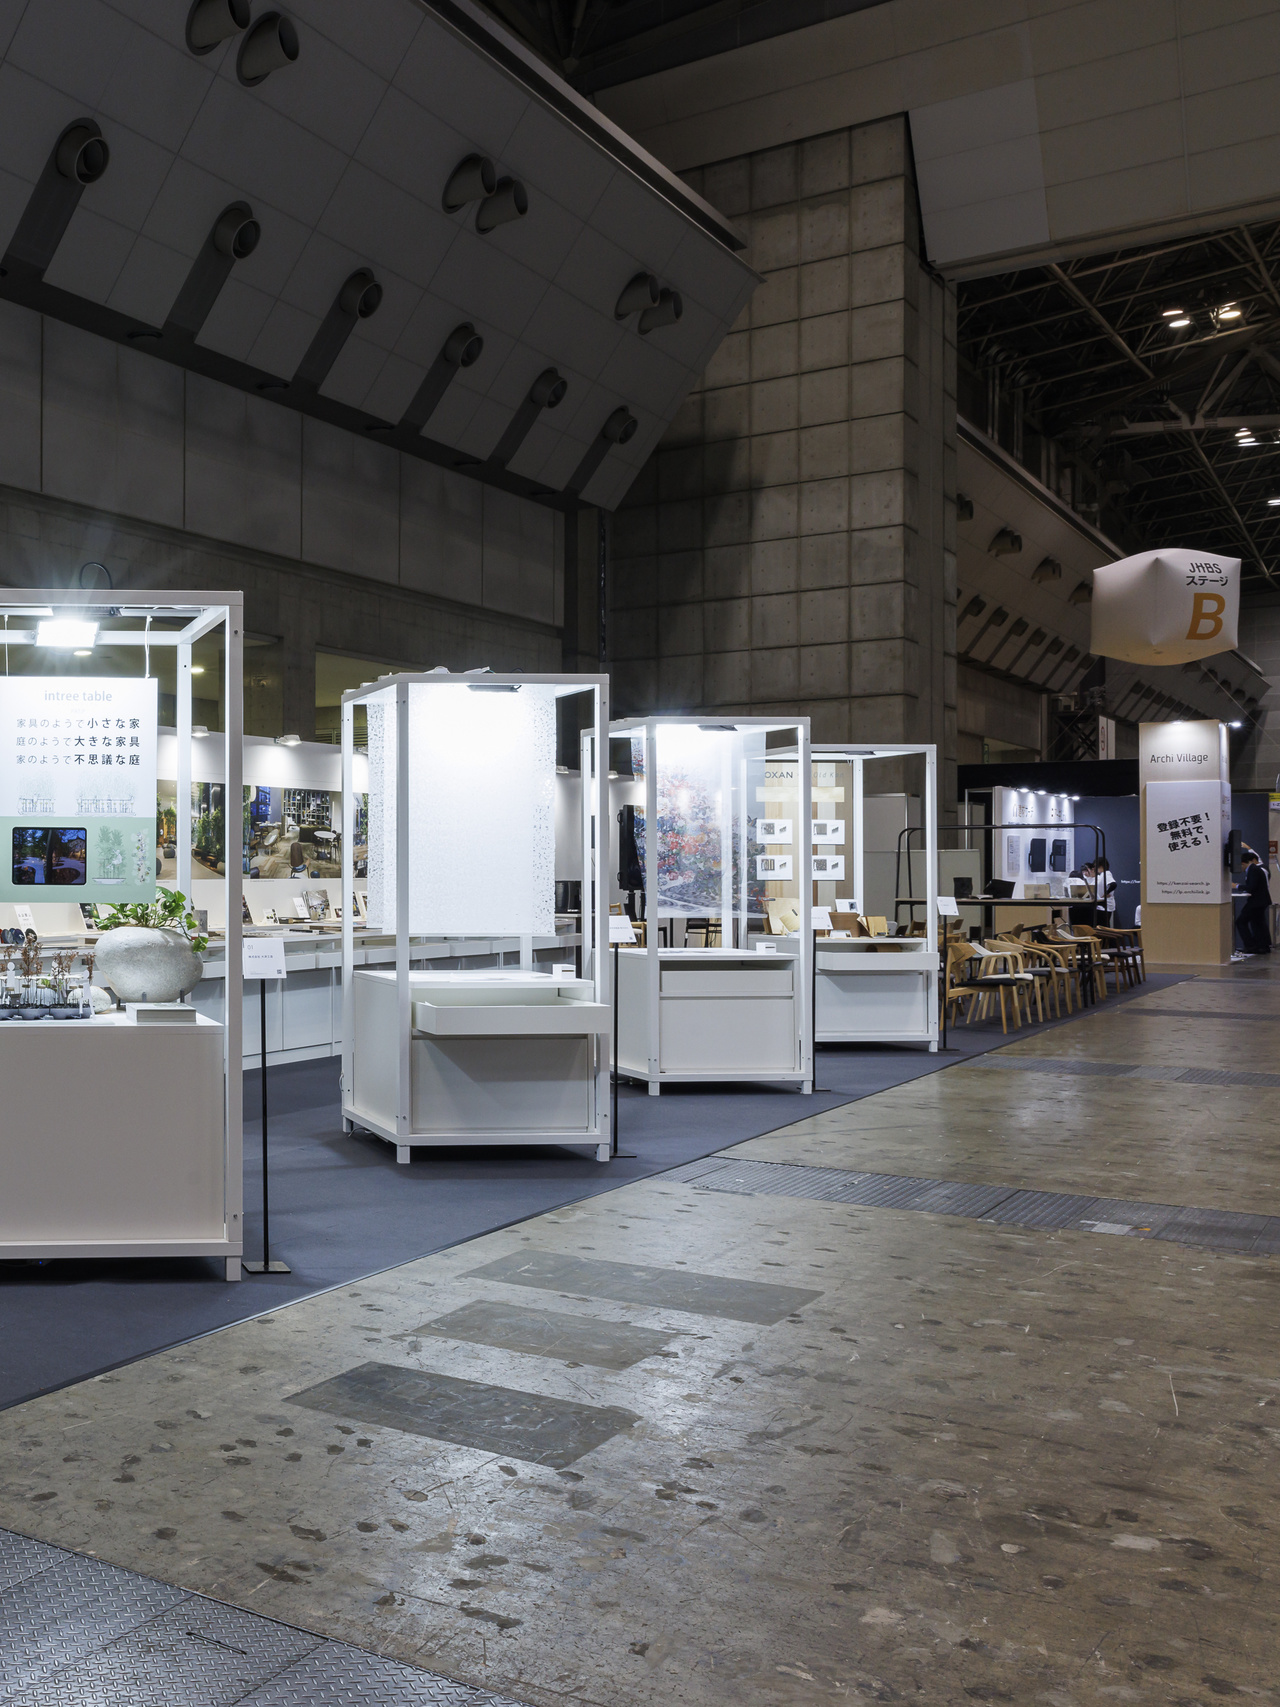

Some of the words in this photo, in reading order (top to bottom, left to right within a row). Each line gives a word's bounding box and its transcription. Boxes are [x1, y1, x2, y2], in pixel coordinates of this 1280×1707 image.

[1189, 562, 1223, 574] JHBS
[1185, 575, 1229, 587] ステージ
[1185, 592, 1226, 640] B
[44, 689, 80, 702] intree
[82, 689, 113, 702] table
[16, 717, 140, 730] 家具のようで小さな家
[15, 735, 140, 748] 庭のようで大きな家具
[15, 753, 141, 766] 家のようで不思議な庭
[1149, 754, 1174, 764] Archi
[1176, 753, 1209, 765] Village
[1156, 812, 1211, 833] 登録不要！
[1169, 825, 1204, 841] 無料で
[1167, 834, 1210, 853] 使える！
